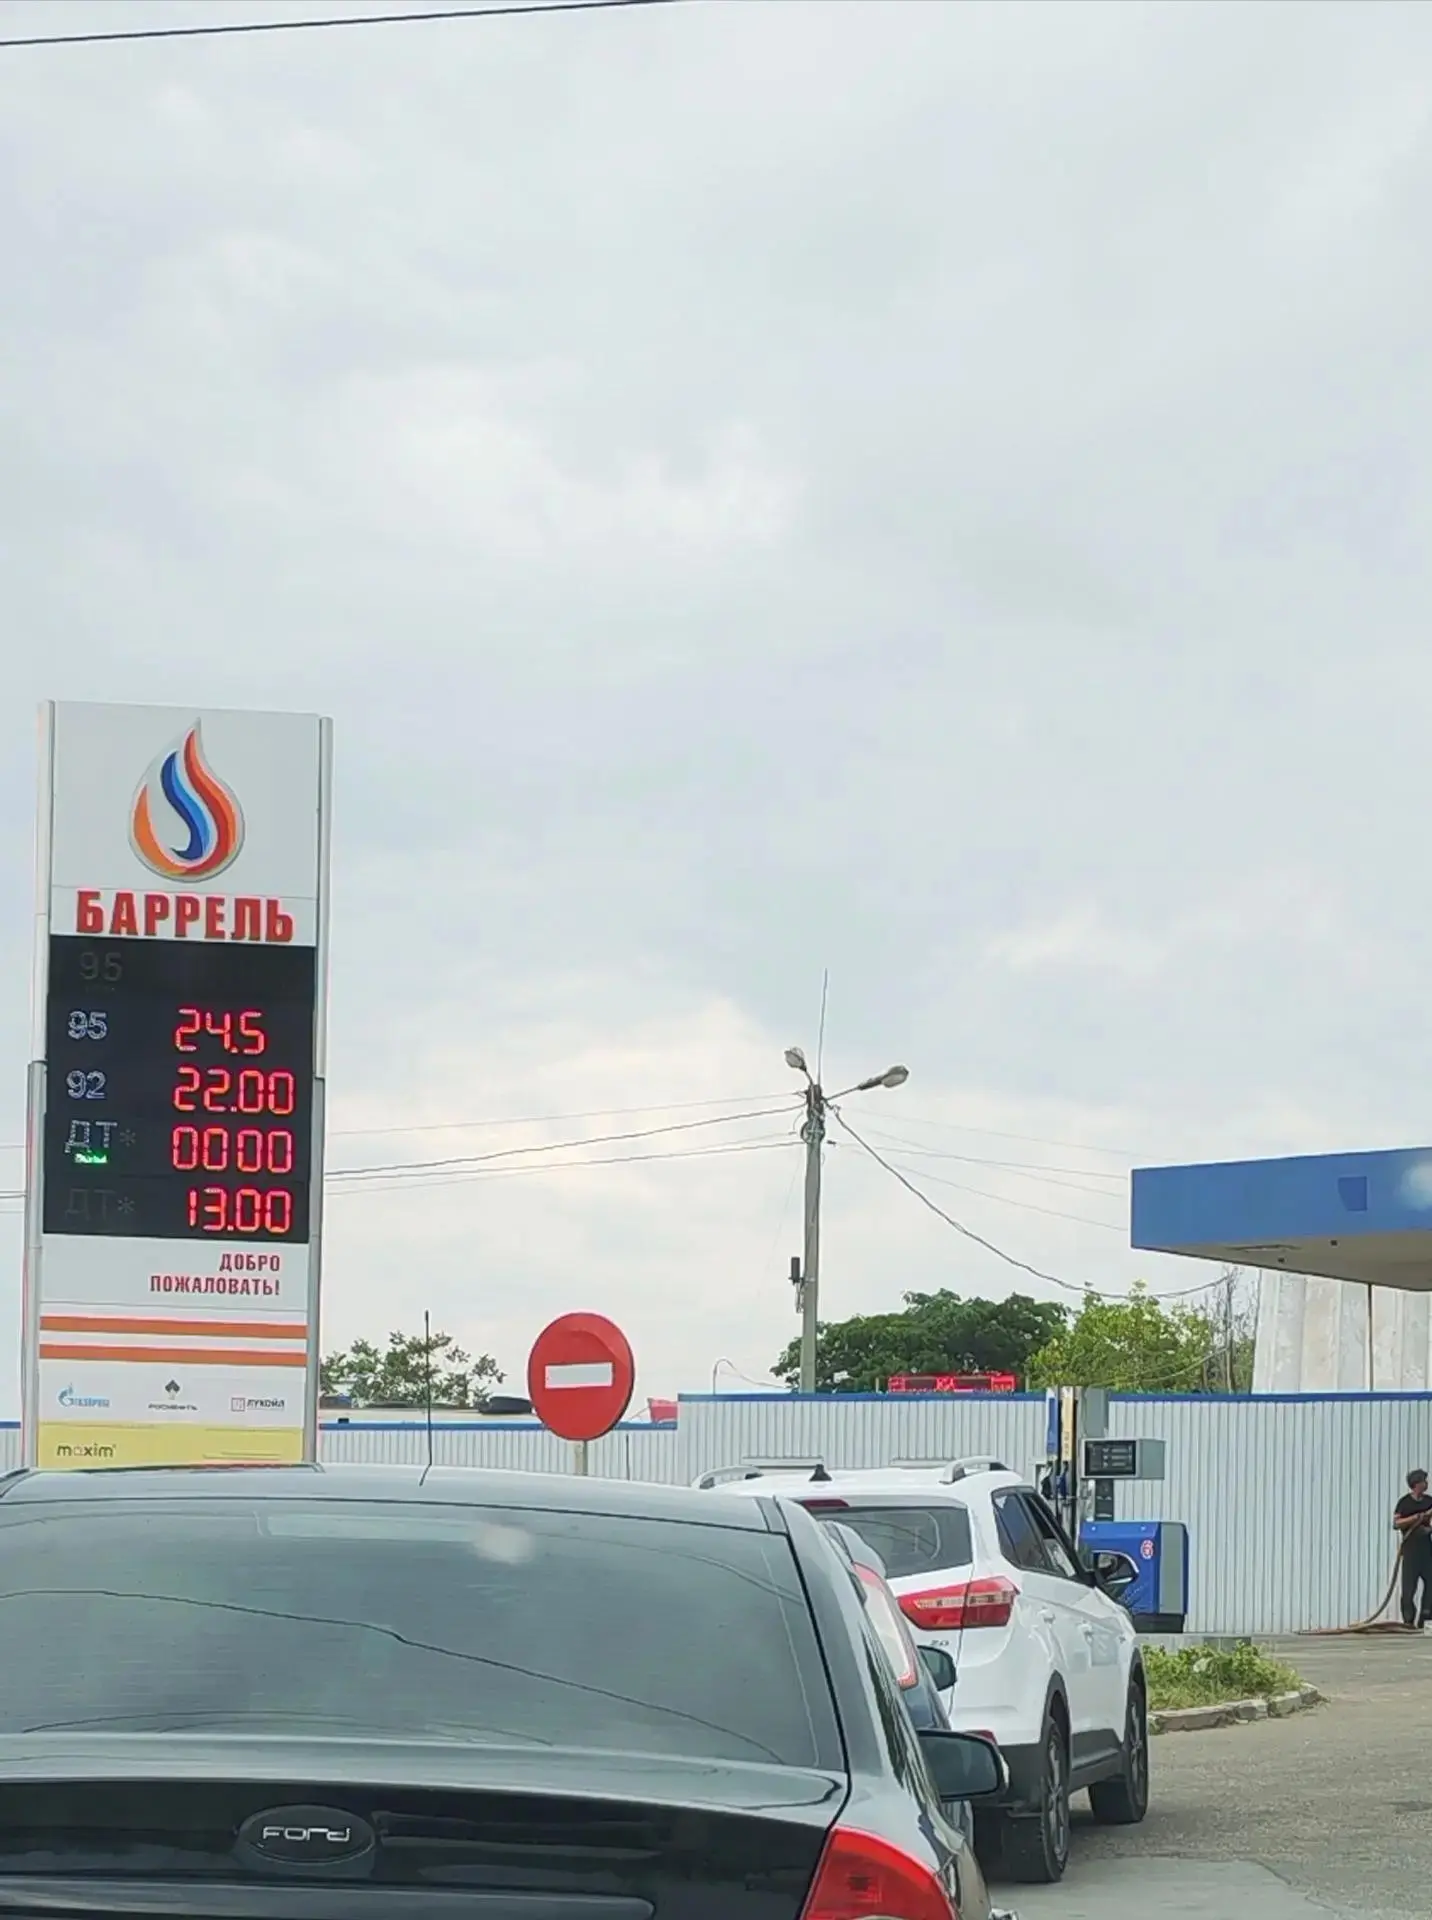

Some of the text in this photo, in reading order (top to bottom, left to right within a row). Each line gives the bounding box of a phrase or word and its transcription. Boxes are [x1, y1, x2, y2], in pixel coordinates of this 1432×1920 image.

[76, 889, 294, 943] БАРРЕЛЬ
[67, 1010, 107, 1040] 95
[174, 1008, 265, 1054] 24.5
[65, 1069, 106, 1100] 92
[173, 1066, 295, 1114] 22.00
[187, 1187, 291, 1233] 13.00
[218, 1253, 281, 1273] ДОБРО
[150, 1275, 280, 1296] ПОЖАЛОВАТЬ!
[57, 1443, 114, 1458] maxim
